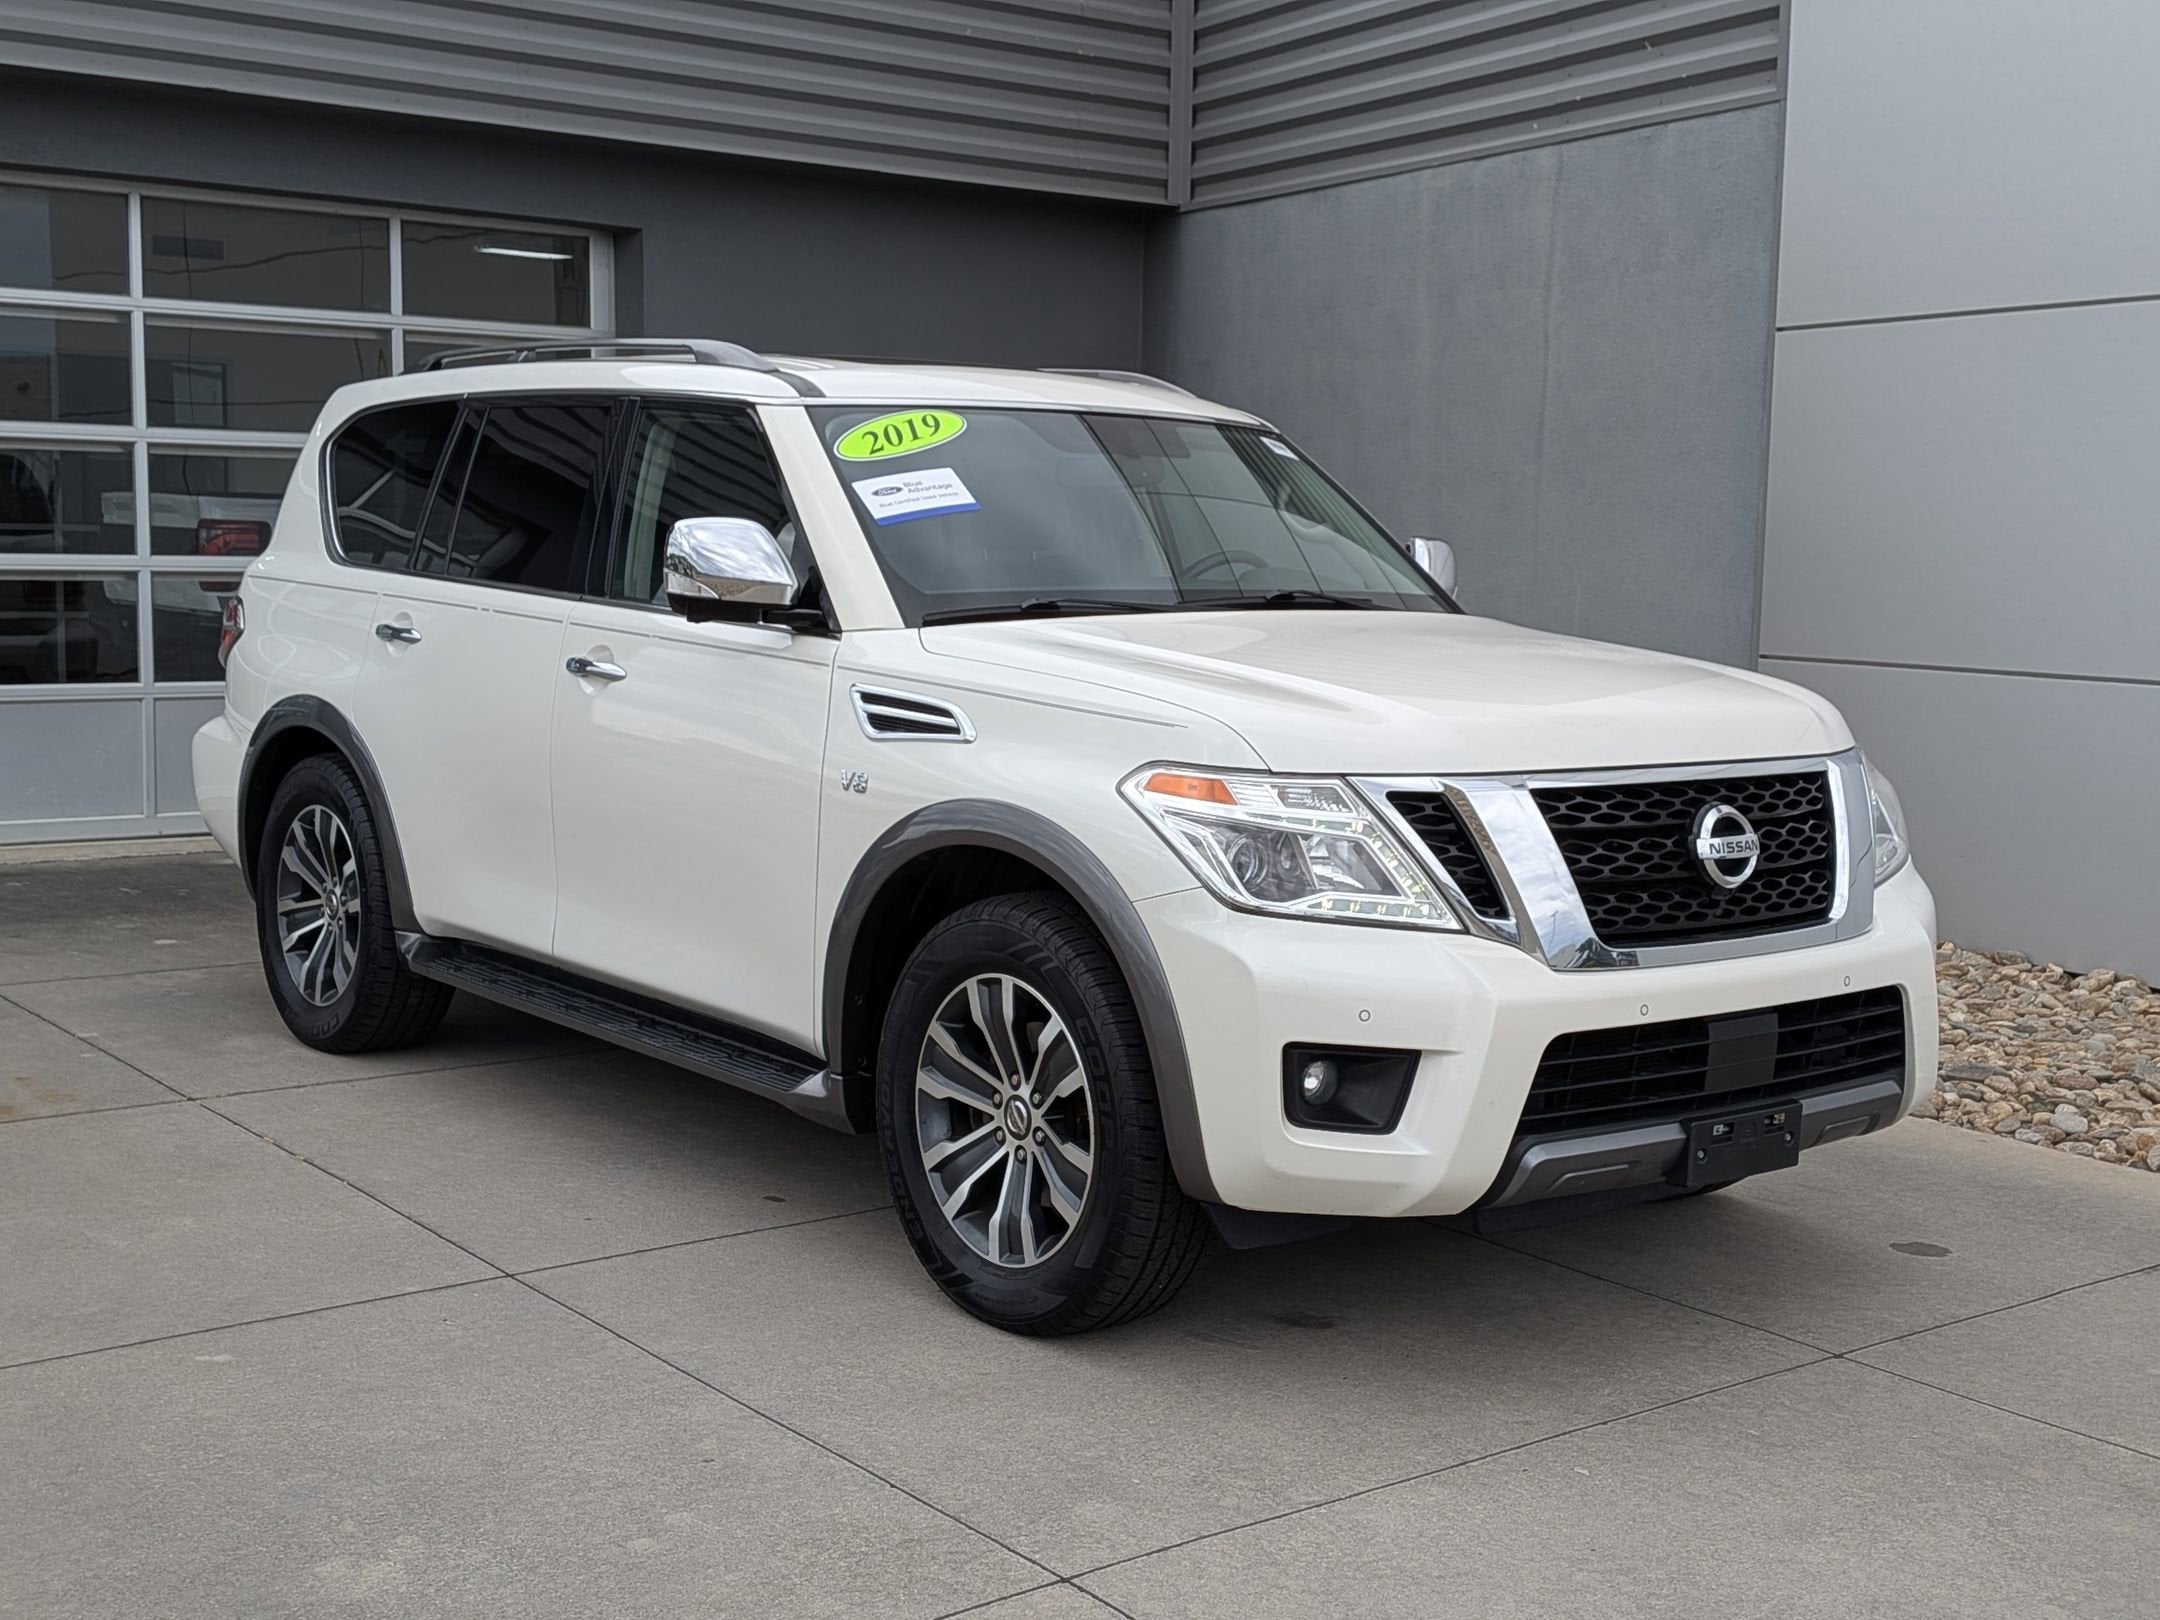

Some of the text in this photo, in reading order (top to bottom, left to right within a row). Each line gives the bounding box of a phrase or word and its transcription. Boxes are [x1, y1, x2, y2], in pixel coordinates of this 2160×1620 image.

[861, 413, 941, 455] 2019
[908, 483, 953, 494] Advantage
[840, 769, 869, 794] V8
[1709, 838, 1759, 855] NISSAN
